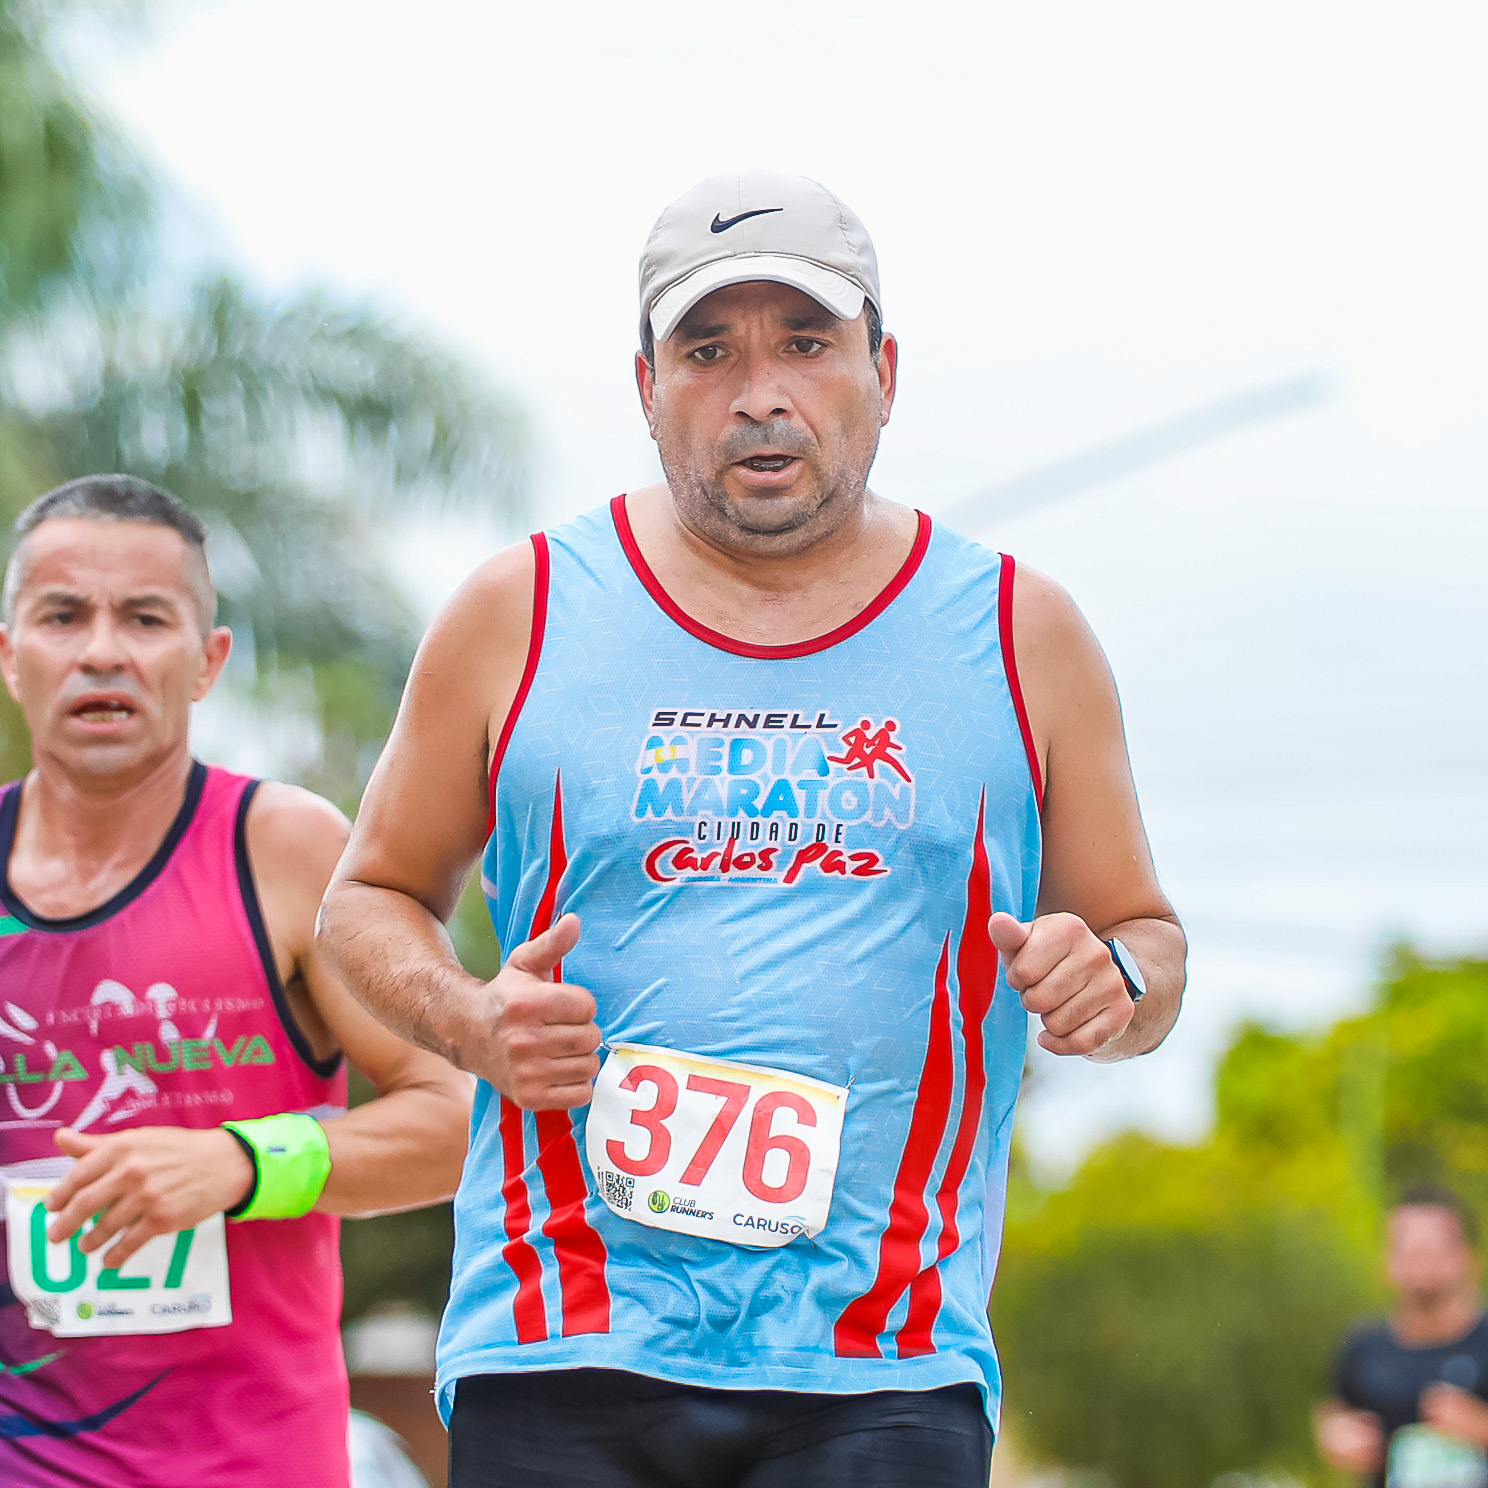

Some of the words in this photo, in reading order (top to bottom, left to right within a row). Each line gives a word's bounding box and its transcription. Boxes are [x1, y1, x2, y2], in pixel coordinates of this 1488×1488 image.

[651, 711, 839, 730] SCHNELL
[639, 734, 831, 778] MEDIA
[634, 777, 913, 828] MARATON
[696, 821, 799, 843] CIUDAD
[815, 823, 844, 844] DE
[645, 838, 779, 882] Carlos
[113, 1034, 276, 1076] NUEVA
[605, 1064, 818, 1204] 376
[670, 1204, 715, 1221] RUNNER'S
[672, 1196, 697, 1208] CLUB
[732, 1213, 803, 1235] CARUSO
